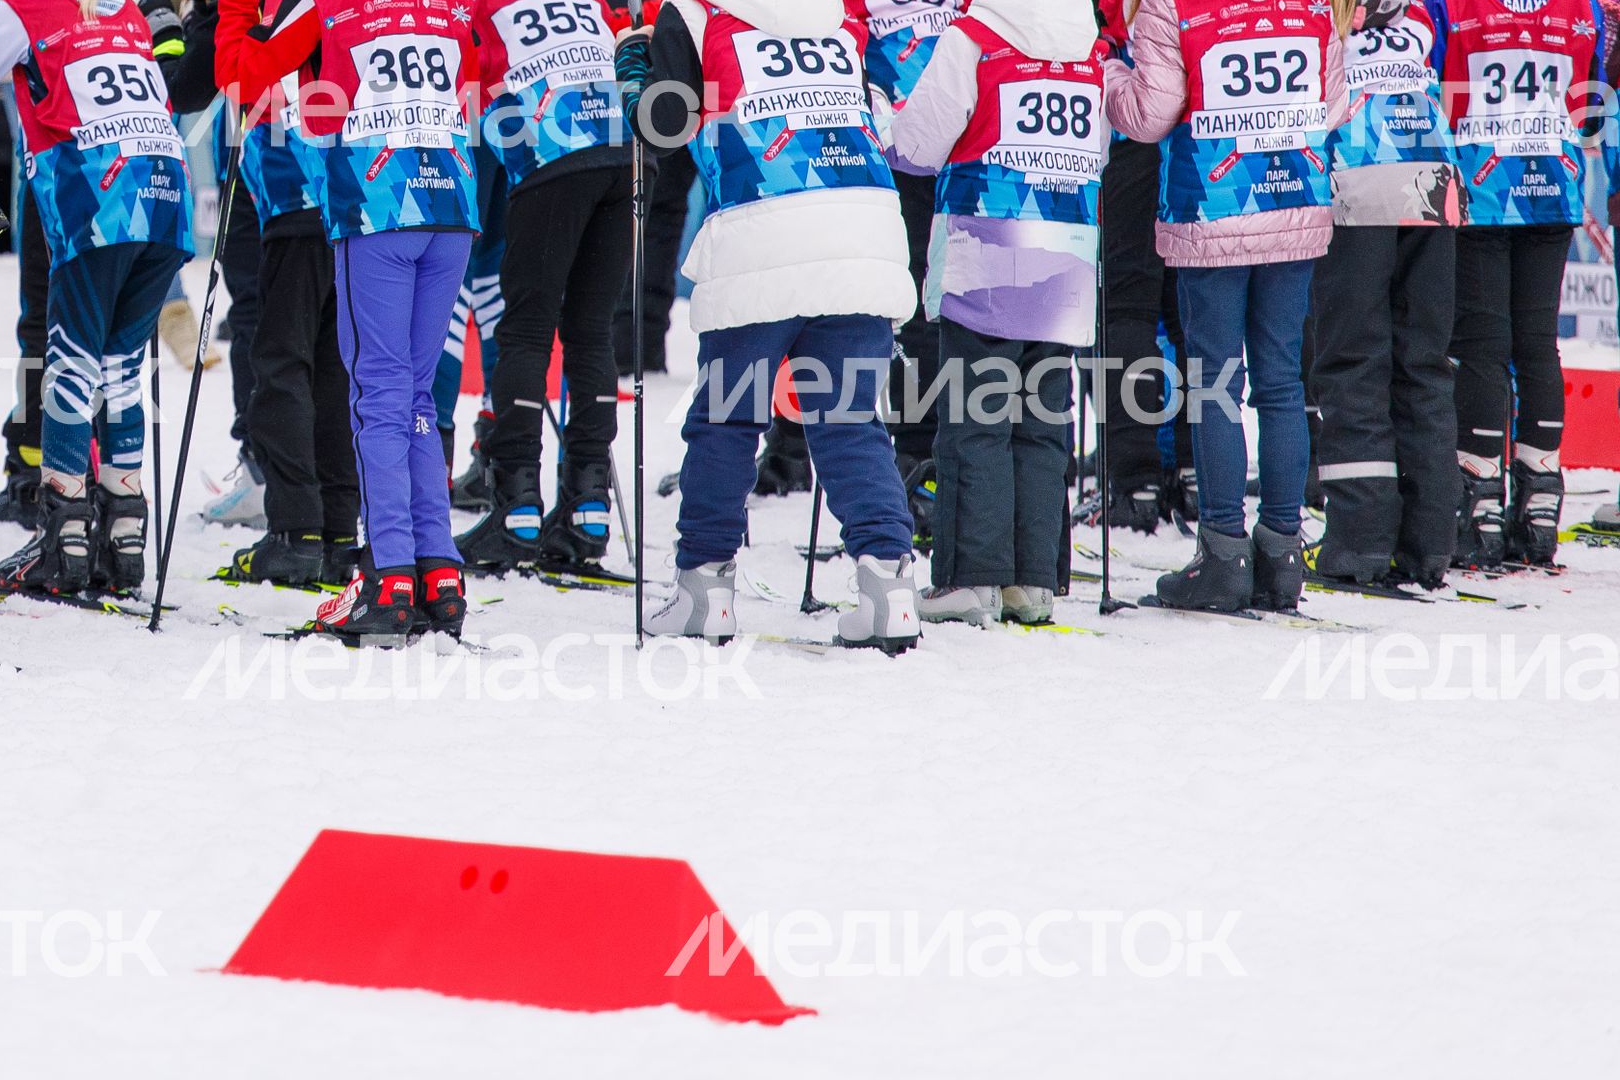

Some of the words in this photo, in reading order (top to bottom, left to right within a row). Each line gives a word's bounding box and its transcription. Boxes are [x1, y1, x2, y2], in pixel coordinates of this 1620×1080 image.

[513, 1, 601, 47] 355
[756, 37, 854, 78] 363
[368, 45, 452, 93] 368
[563, 68, 603, 82] ЛЫЖНЯ
[1220, 49, 1309, 97] 352
[581, 97, 607, 109] ПАРК
[805, 112, 849, 126] ЛЫЖНЯ
[1016, 91, 1093, 140] 388
[1394, 107, 1418, 119] ПАРК
[1196, 106, 1327, 135] МАНЖОСОВСКАЯ
[136, 141, 174, 154] ЛЫЖНЯ
[1254, 135, 1294, 149] ЛЫЖНЯ
[1511, 140, 1550, 153] ЛЫЖНЯ
[820, 145, 850, 157] ПАРК
[808, 153, 868, 168] ЛАЗУТИНОЙ
[419, 165, 441, 178] ПАРК
[1266, 169, 1291, 182] ПАРК
[150, 174, 172, 187] ПАРК
[406, 176, 456, 190] ЛАЗУТИНОЙ
[1522, 173, 1548, 186] ПАРК
[1250, 179, 1305, 195] ЛАЗУТИНОЙ
[1510, 183, 1561, 198] ЛАЗУТИНОЙ
